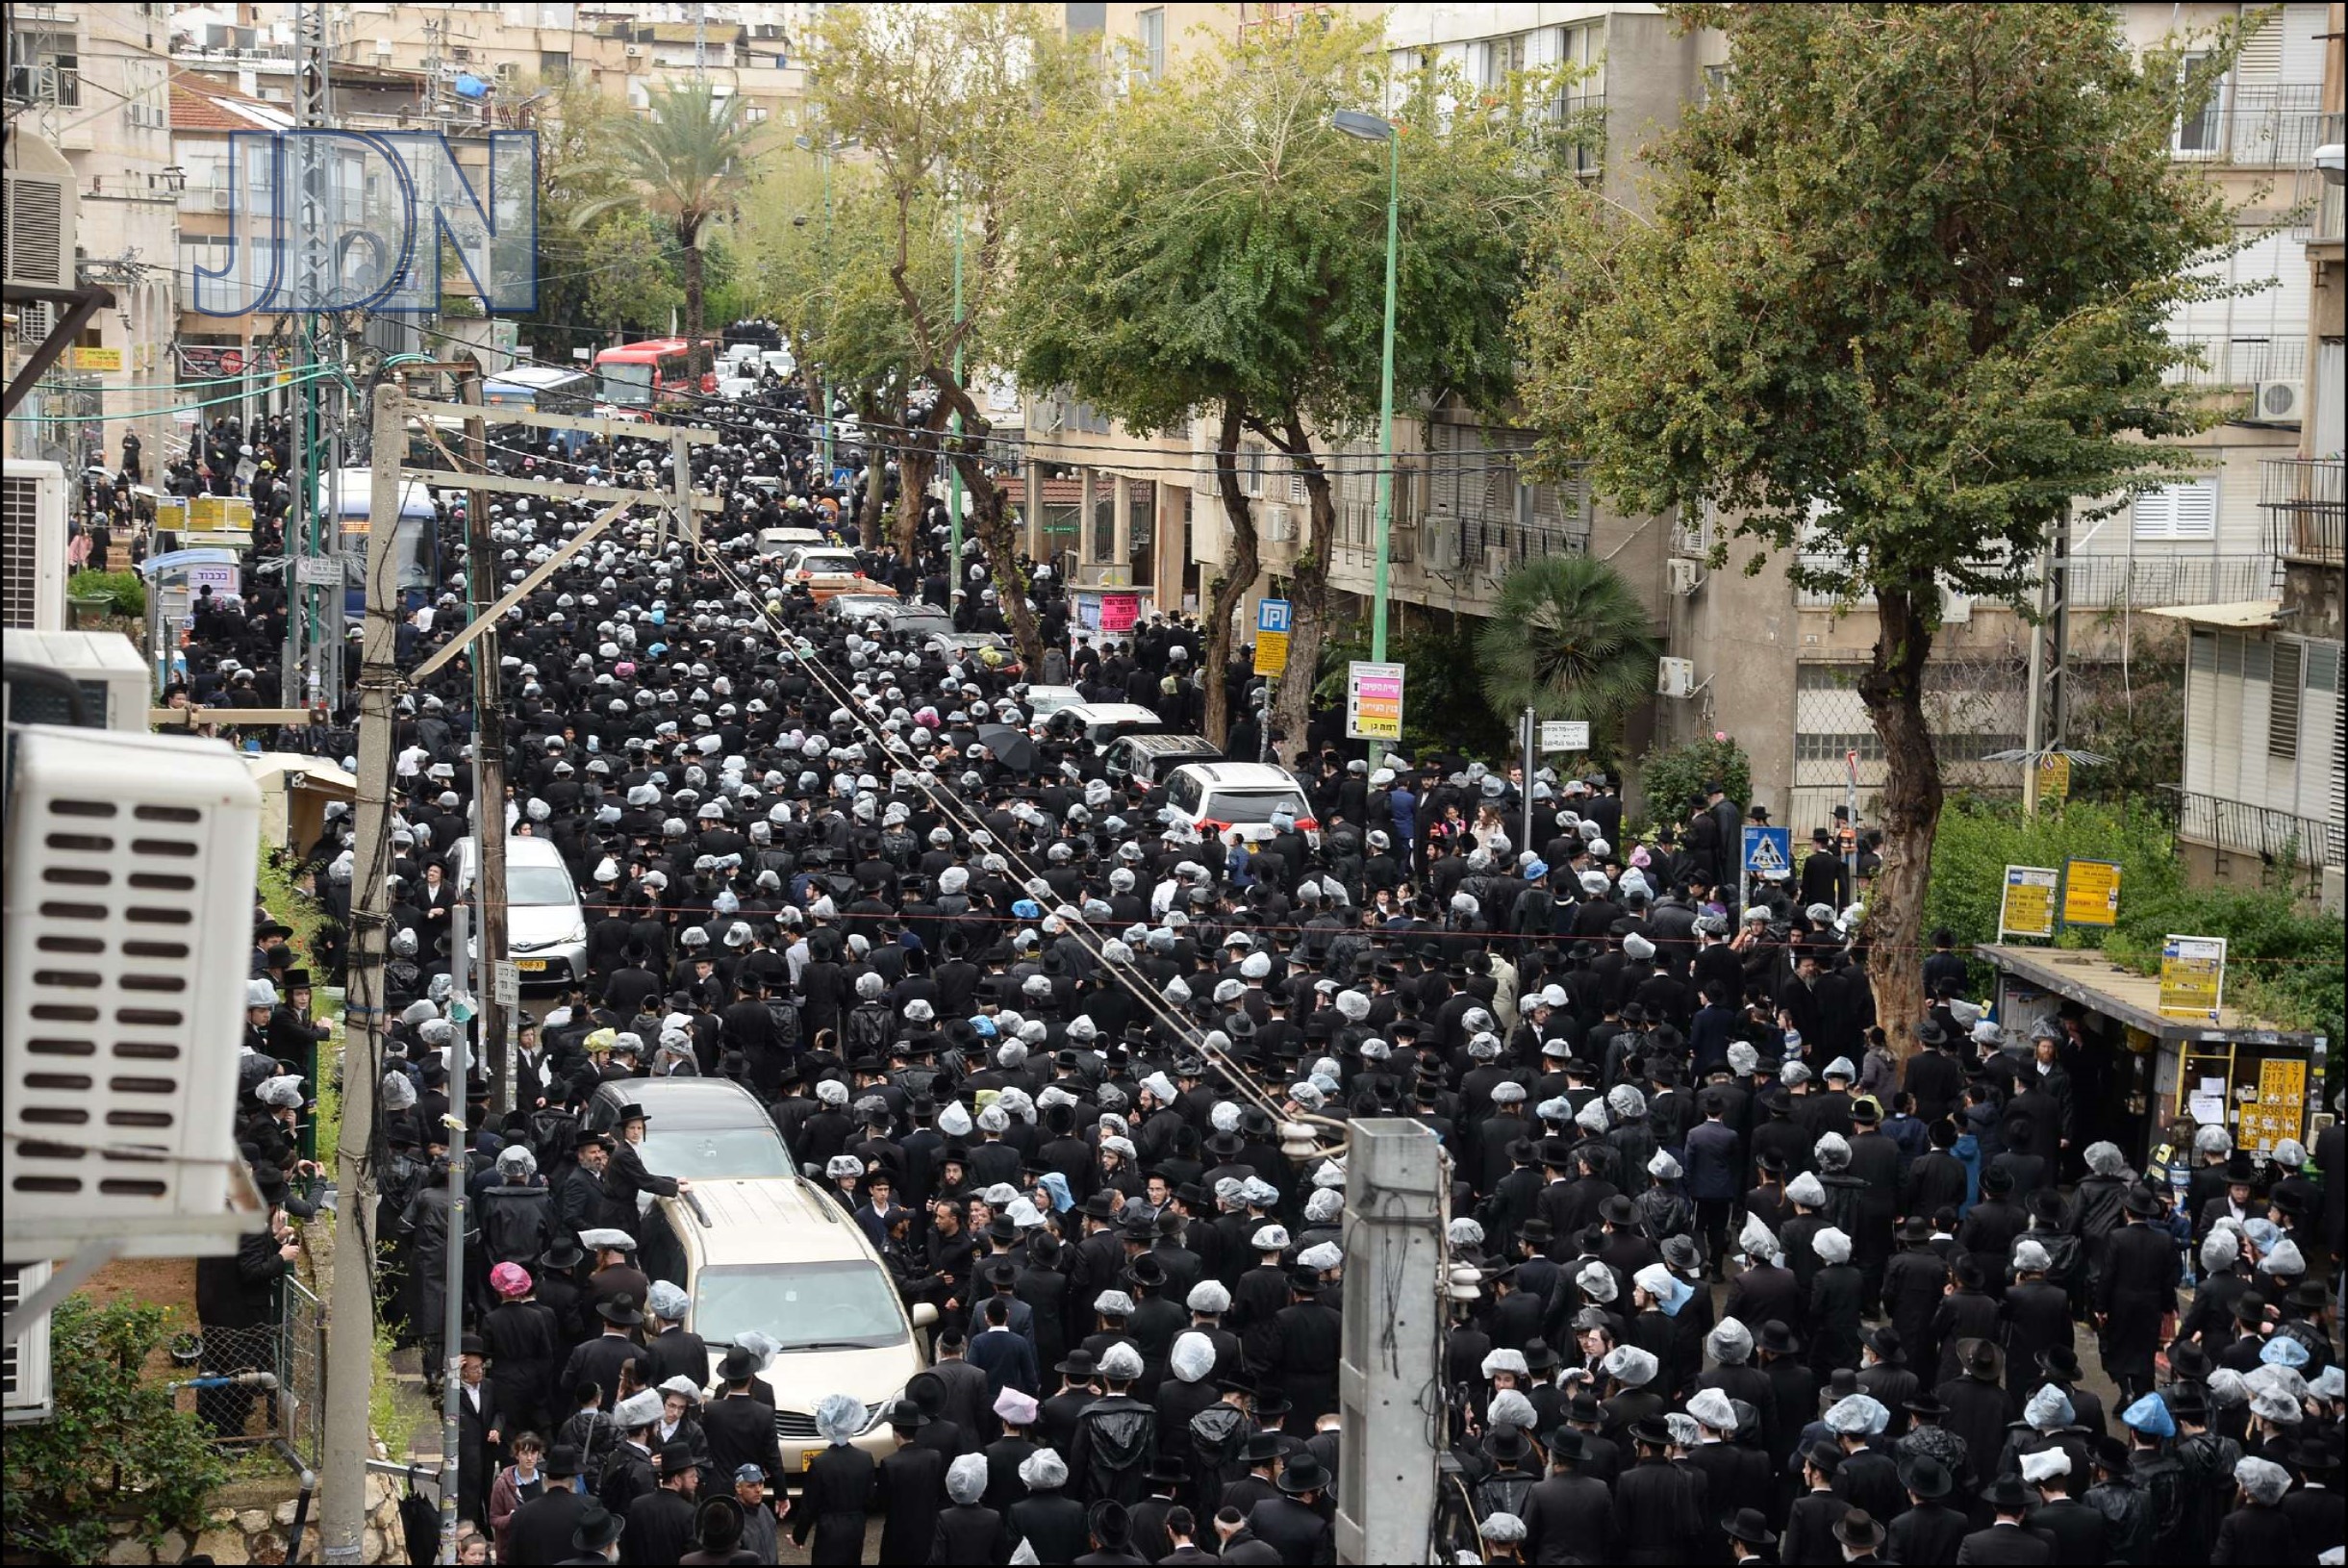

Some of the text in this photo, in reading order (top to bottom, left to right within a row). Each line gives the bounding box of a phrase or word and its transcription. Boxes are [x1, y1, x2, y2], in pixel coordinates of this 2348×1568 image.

[2264, 1061, 2299, 1071] 292 3
[2263, 1072, 2300, 1082] 917 7
[2262, 1083, 2299, 1094] 918 11
